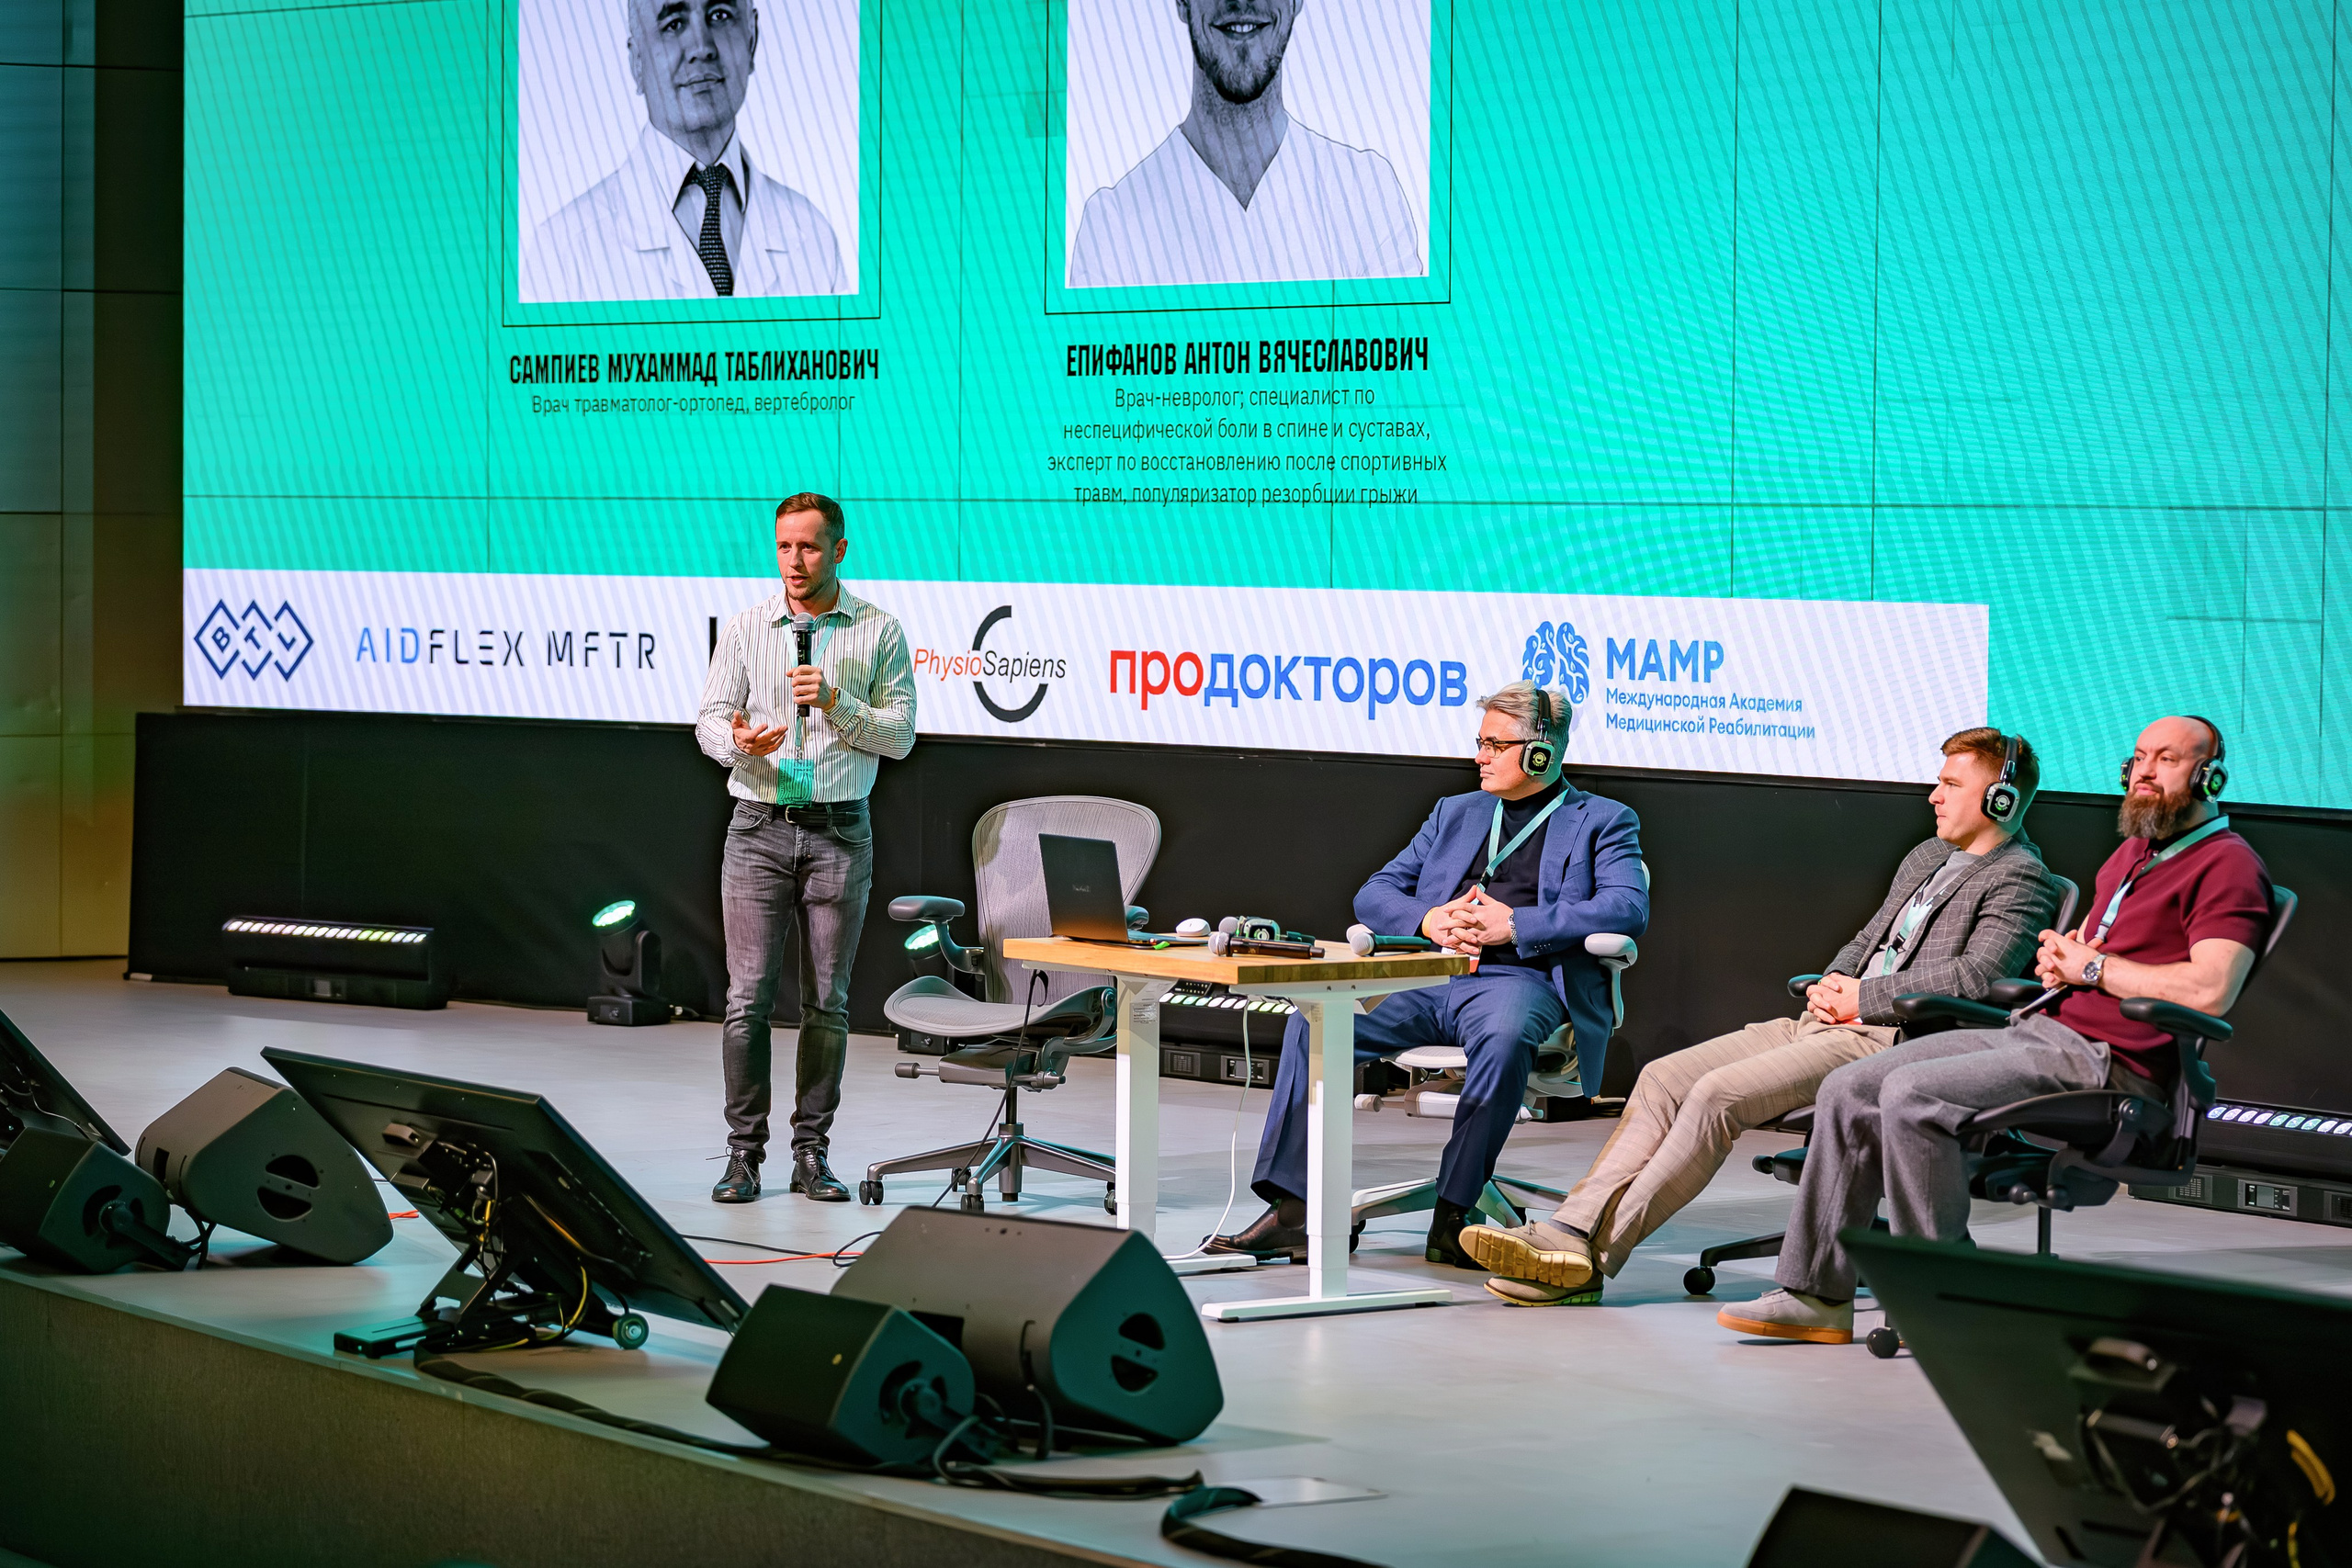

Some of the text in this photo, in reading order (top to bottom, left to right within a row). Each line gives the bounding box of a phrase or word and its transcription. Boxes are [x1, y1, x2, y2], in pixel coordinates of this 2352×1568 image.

[510, 348, 879, 387] САМПИЕВ МУХАММАД ТАБЛИХАНОВИЧ
[1067, 336, 1429, 377] ЕПИФАНОВ АНТОН ВЯЧЕСЛАВОВИЧ
[533, 391, 855, 416] Врач травматолог-ортопед, вертебролог
[1114, 387, 1375, 412] Врач-невролог; специалист по
[1063, 418, 1430, 443] неспецифической боли в спине и суставах,
[1047, 454, 1447, 476] эксперт по восстановлению после спортивных
[1075, 483, 1418, 508] травм, популяризатор резорбции грыжи
[548, 630, 657, 670] MFTR
[914, 647, 1067, 683] PhysioSapiens
[1607, 687, 1803, 714] Международная Академия
[1607, 713, 1815, 740] Медицинской Реабилитации
